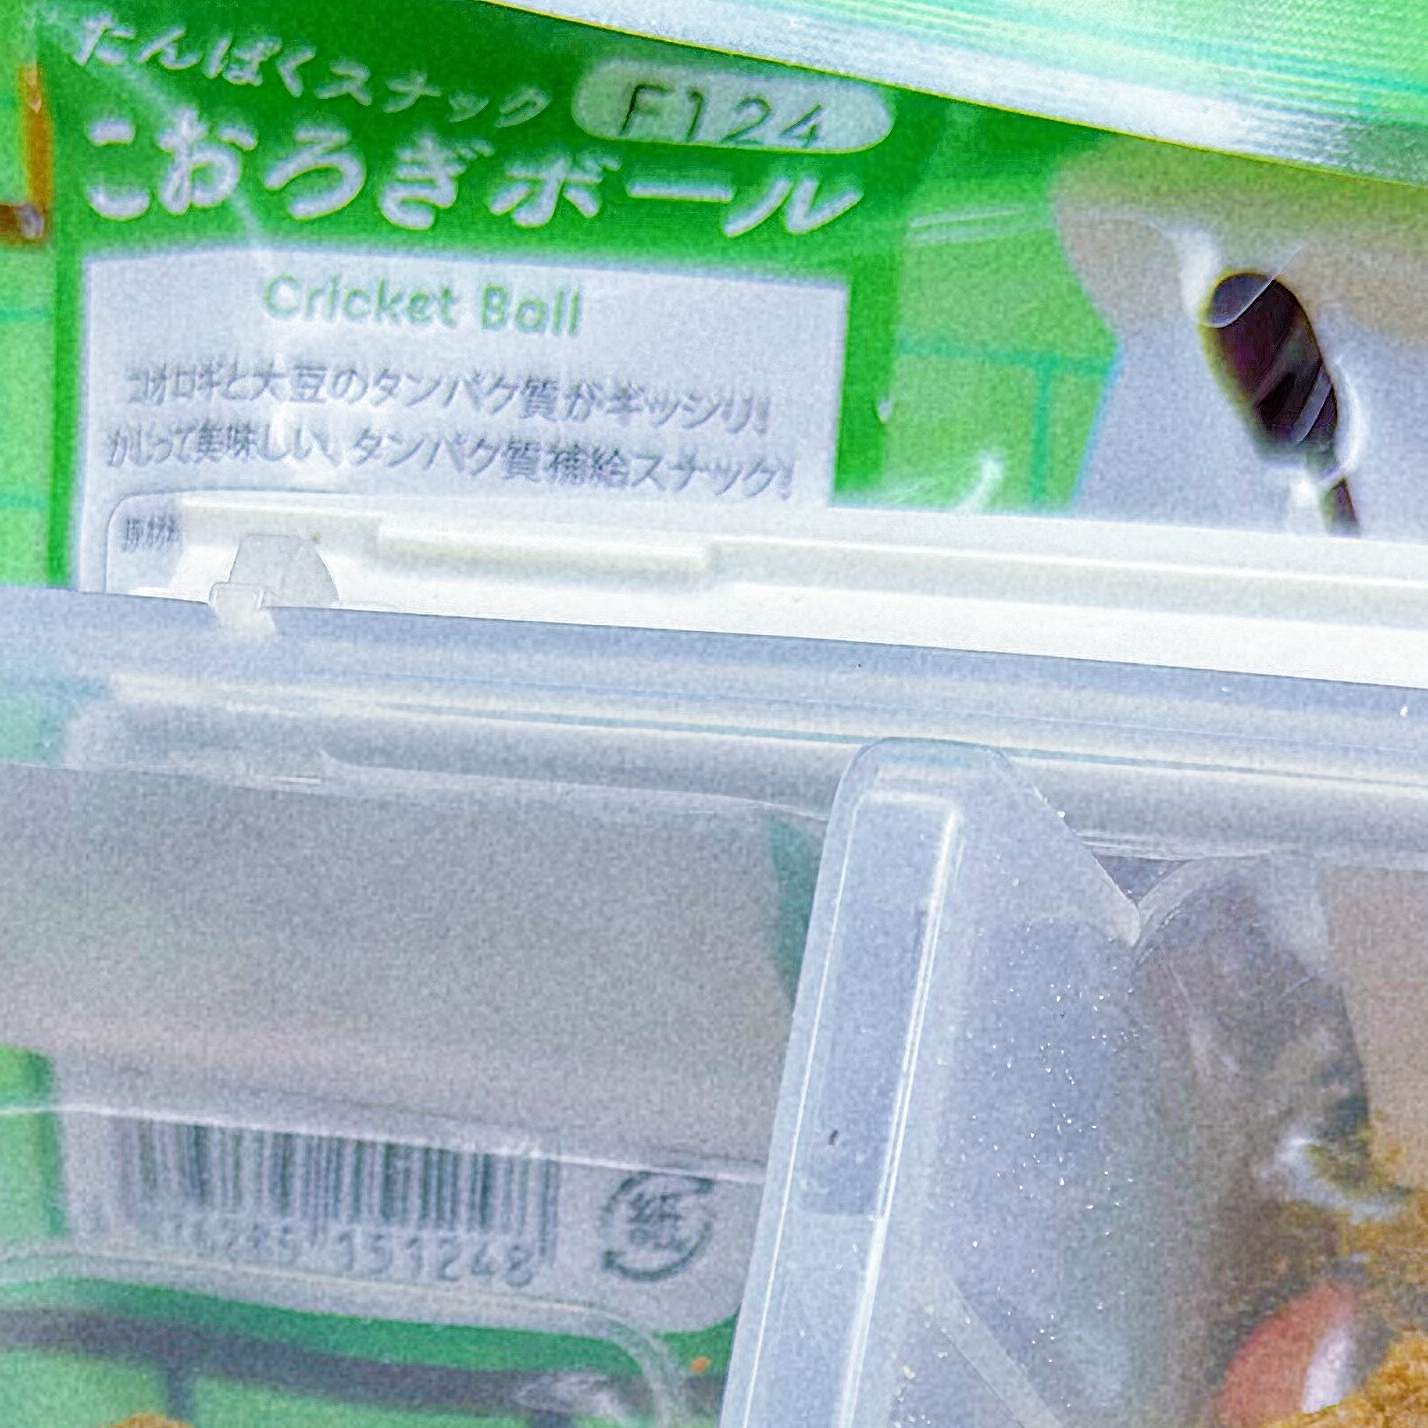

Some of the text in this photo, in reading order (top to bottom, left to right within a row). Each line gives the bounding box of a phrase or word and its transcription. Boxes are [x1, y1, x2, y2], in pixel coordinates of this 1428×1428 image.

[74, 12, 552, 128] たんぱくスナック
[619, 82, 823, 149] F124
[87, 104, 864, 238] こおろぎボール
[265, 272, 582, 336] Cricket Ball
